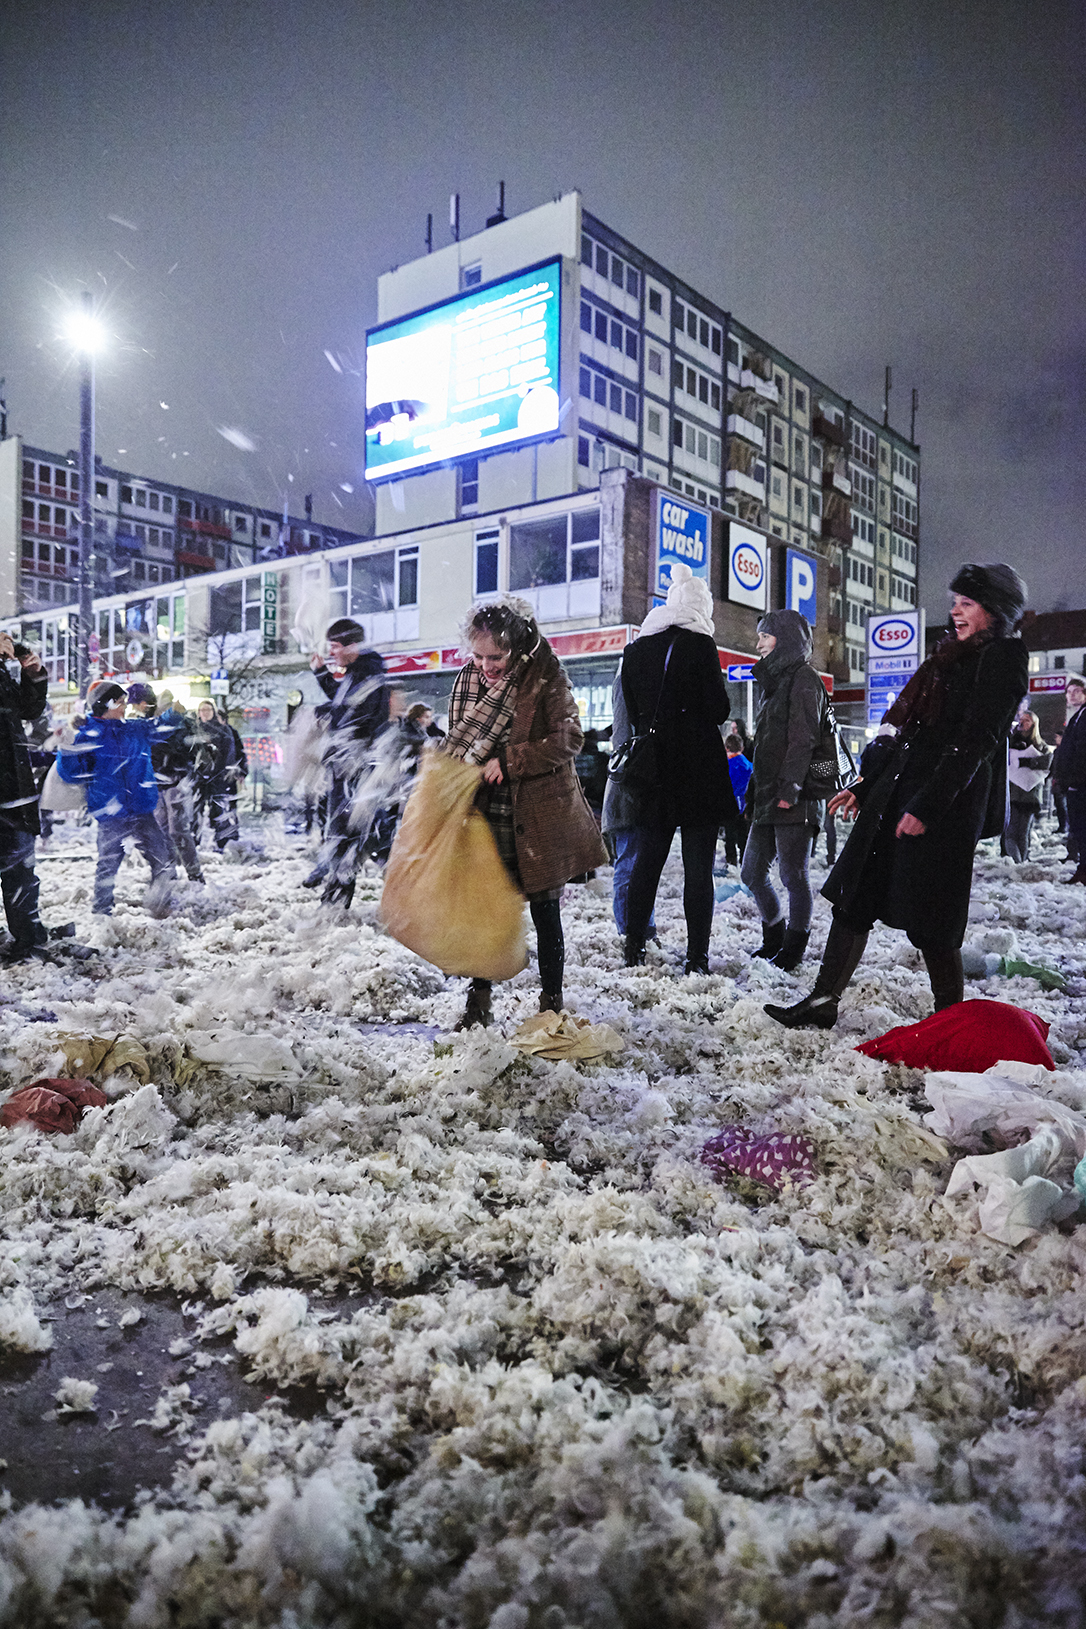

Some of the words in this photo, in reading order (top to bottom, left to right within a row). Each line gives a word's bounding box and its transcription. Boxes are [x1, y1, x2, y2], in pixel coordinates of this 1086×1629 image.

[662, 502, 689, 530] car
[662, 526, 704, 562] wash
[737, 553, 760, 578] Esso
[791, 557, 814, 613] P
[264, 572, 277, 655] HOTEL
[879, 629, 909, 641] Esso
[875, 660, 901, 670] Mobil
[1033, 678, 1065, 688] ESSO
